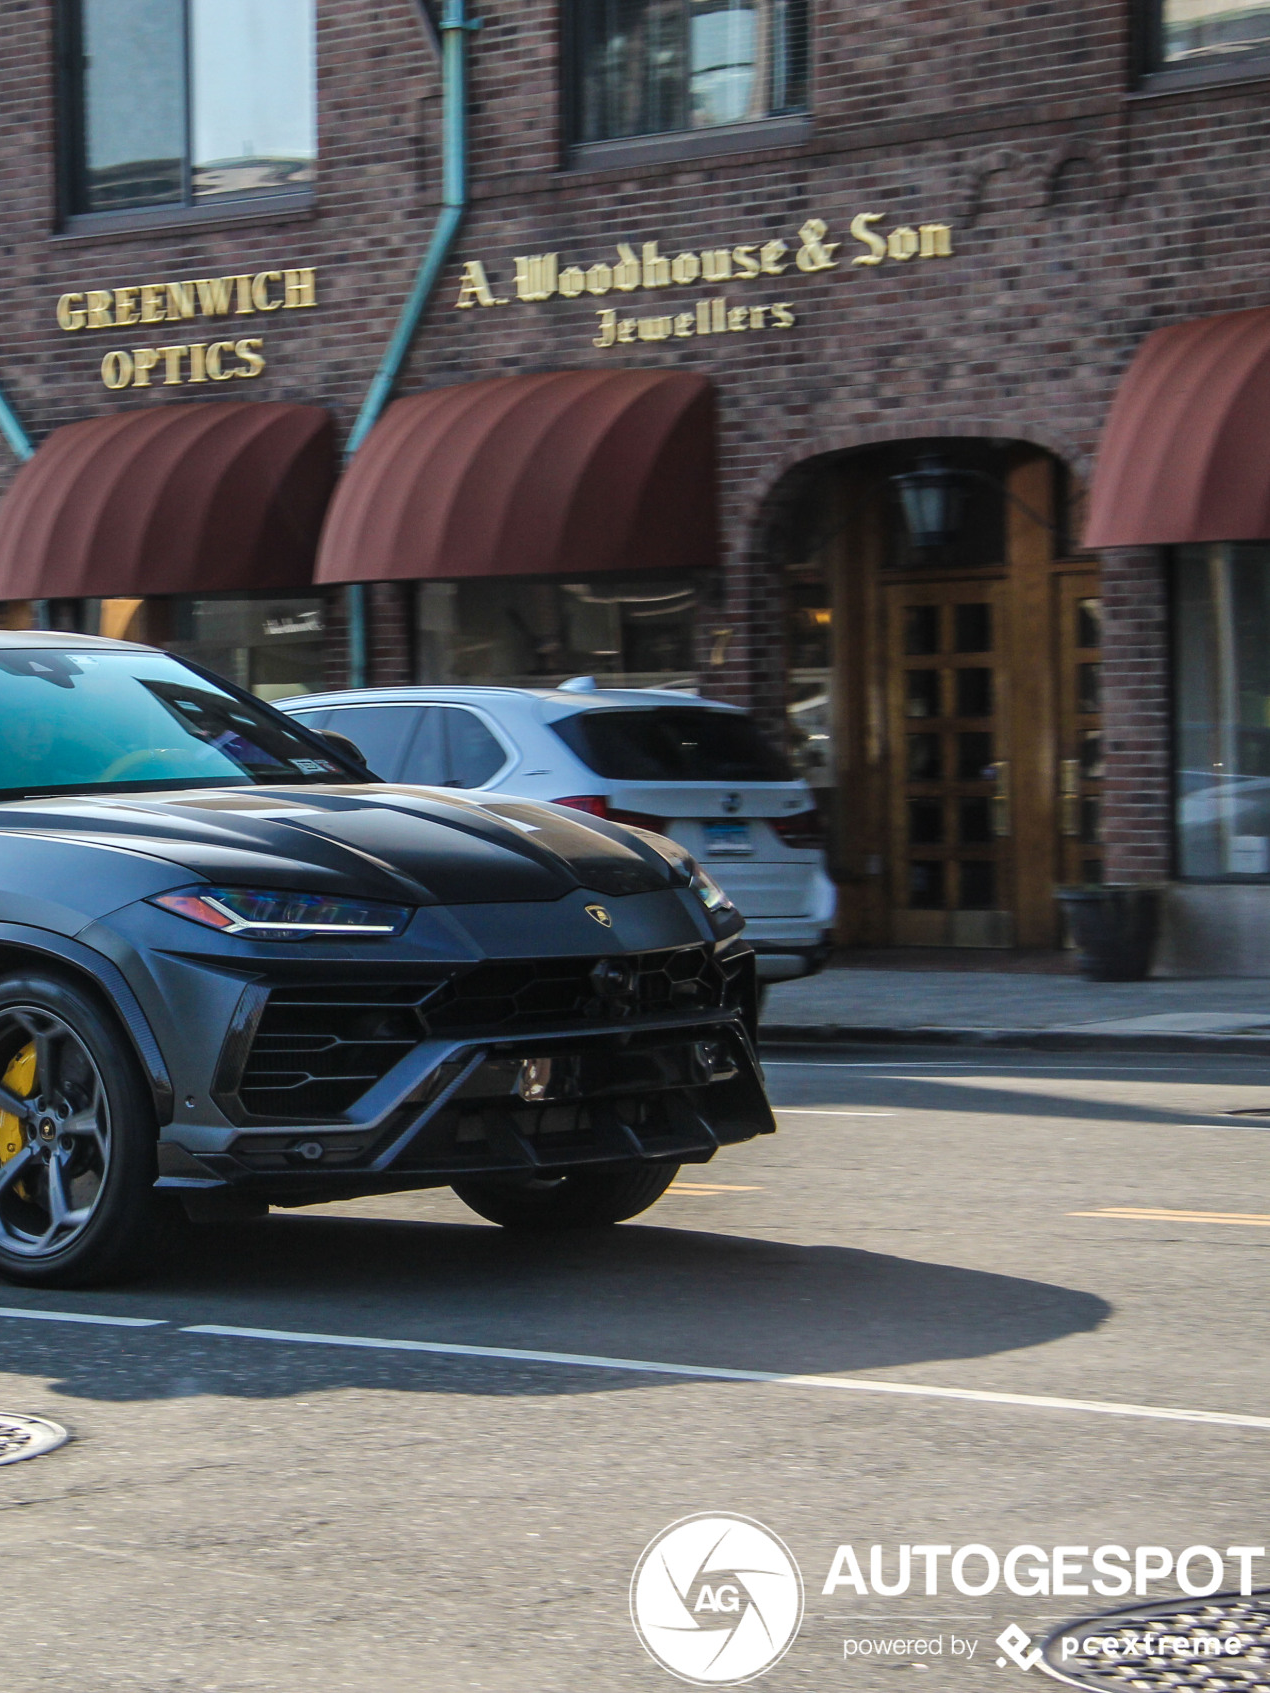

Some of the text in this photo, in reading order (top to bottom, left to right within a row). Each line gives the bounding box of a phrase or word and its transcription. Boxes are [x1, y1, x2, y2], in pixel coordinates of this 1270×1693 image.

[455, 211, 953, 309] A. Woodhouse & Son
[56, 267, 318, 331] GREENWICH
[592, 297, 795, 348] Jewellers
[101, 338, 266, 389] OPTICS
